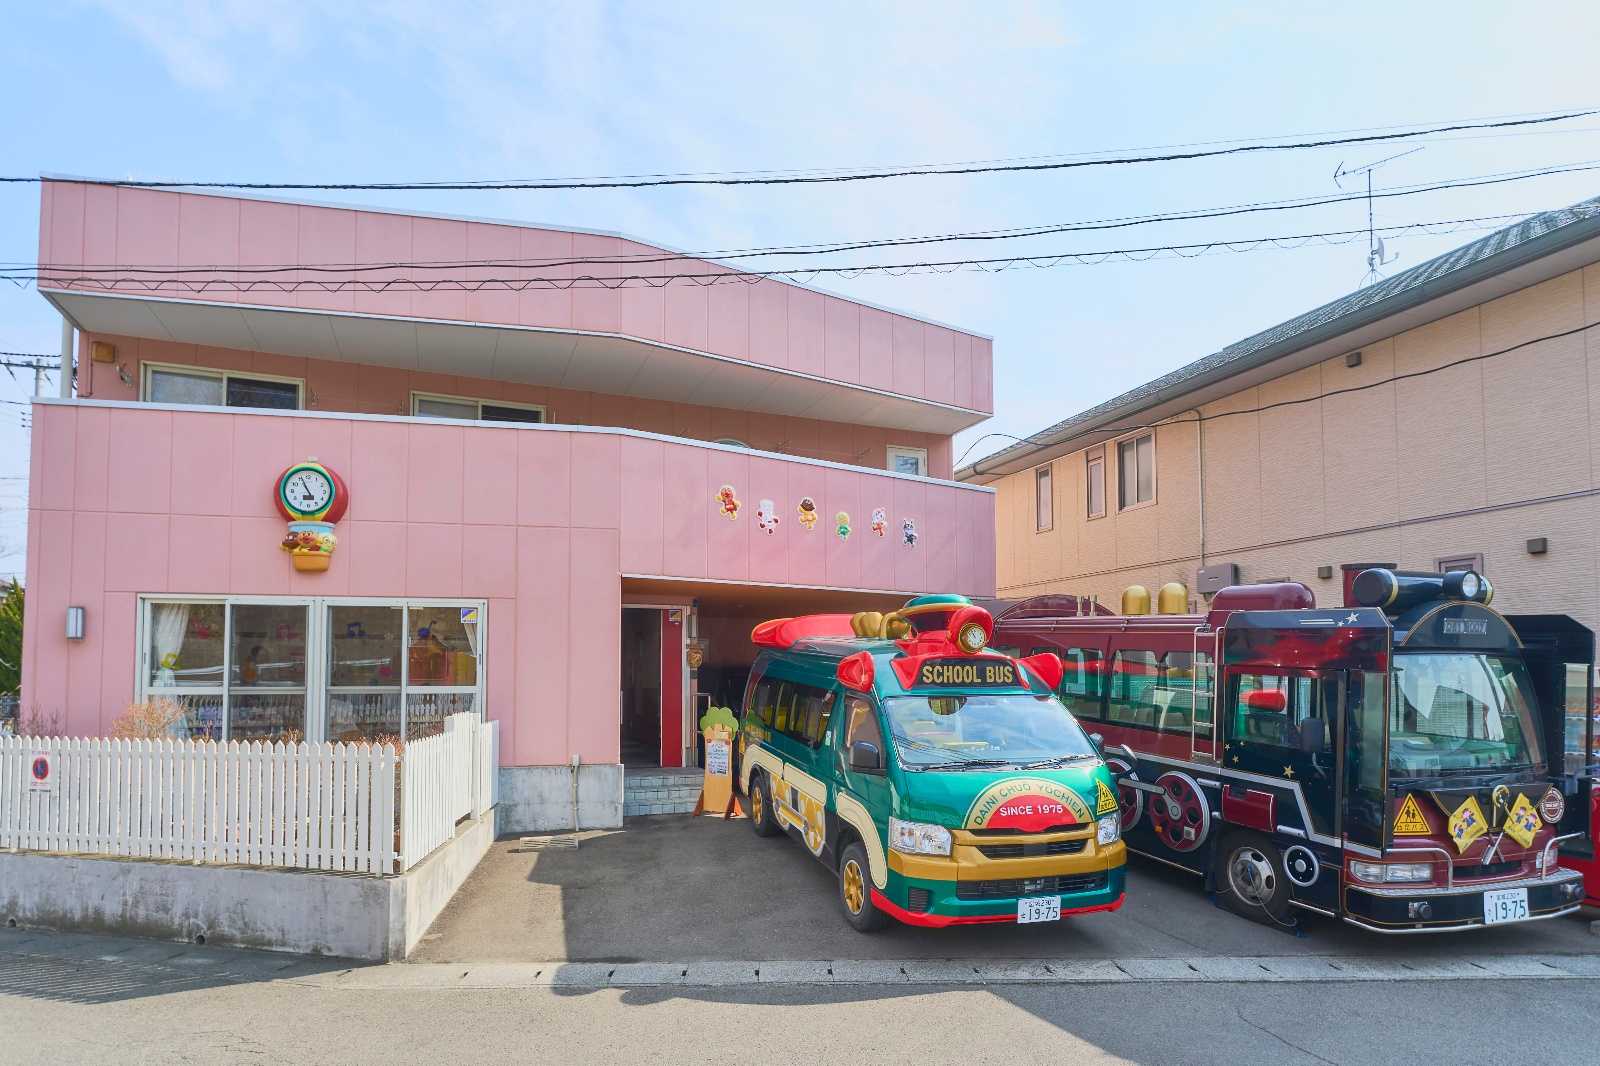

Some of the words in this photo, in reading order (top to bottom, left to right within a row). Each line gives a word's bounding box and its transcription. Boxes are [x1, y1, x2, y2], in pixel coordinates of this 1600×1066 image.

[922, 665, 982, 684] SCHOOL
[986, 665, 1013, 684] BUS
[974, 794, 999, 826] DAINI
[1000, 804, 1033, 817] SINCE
[1029, 906, 1058, 921] 19-75
[1494, 899, 1526, 921] 19-75
